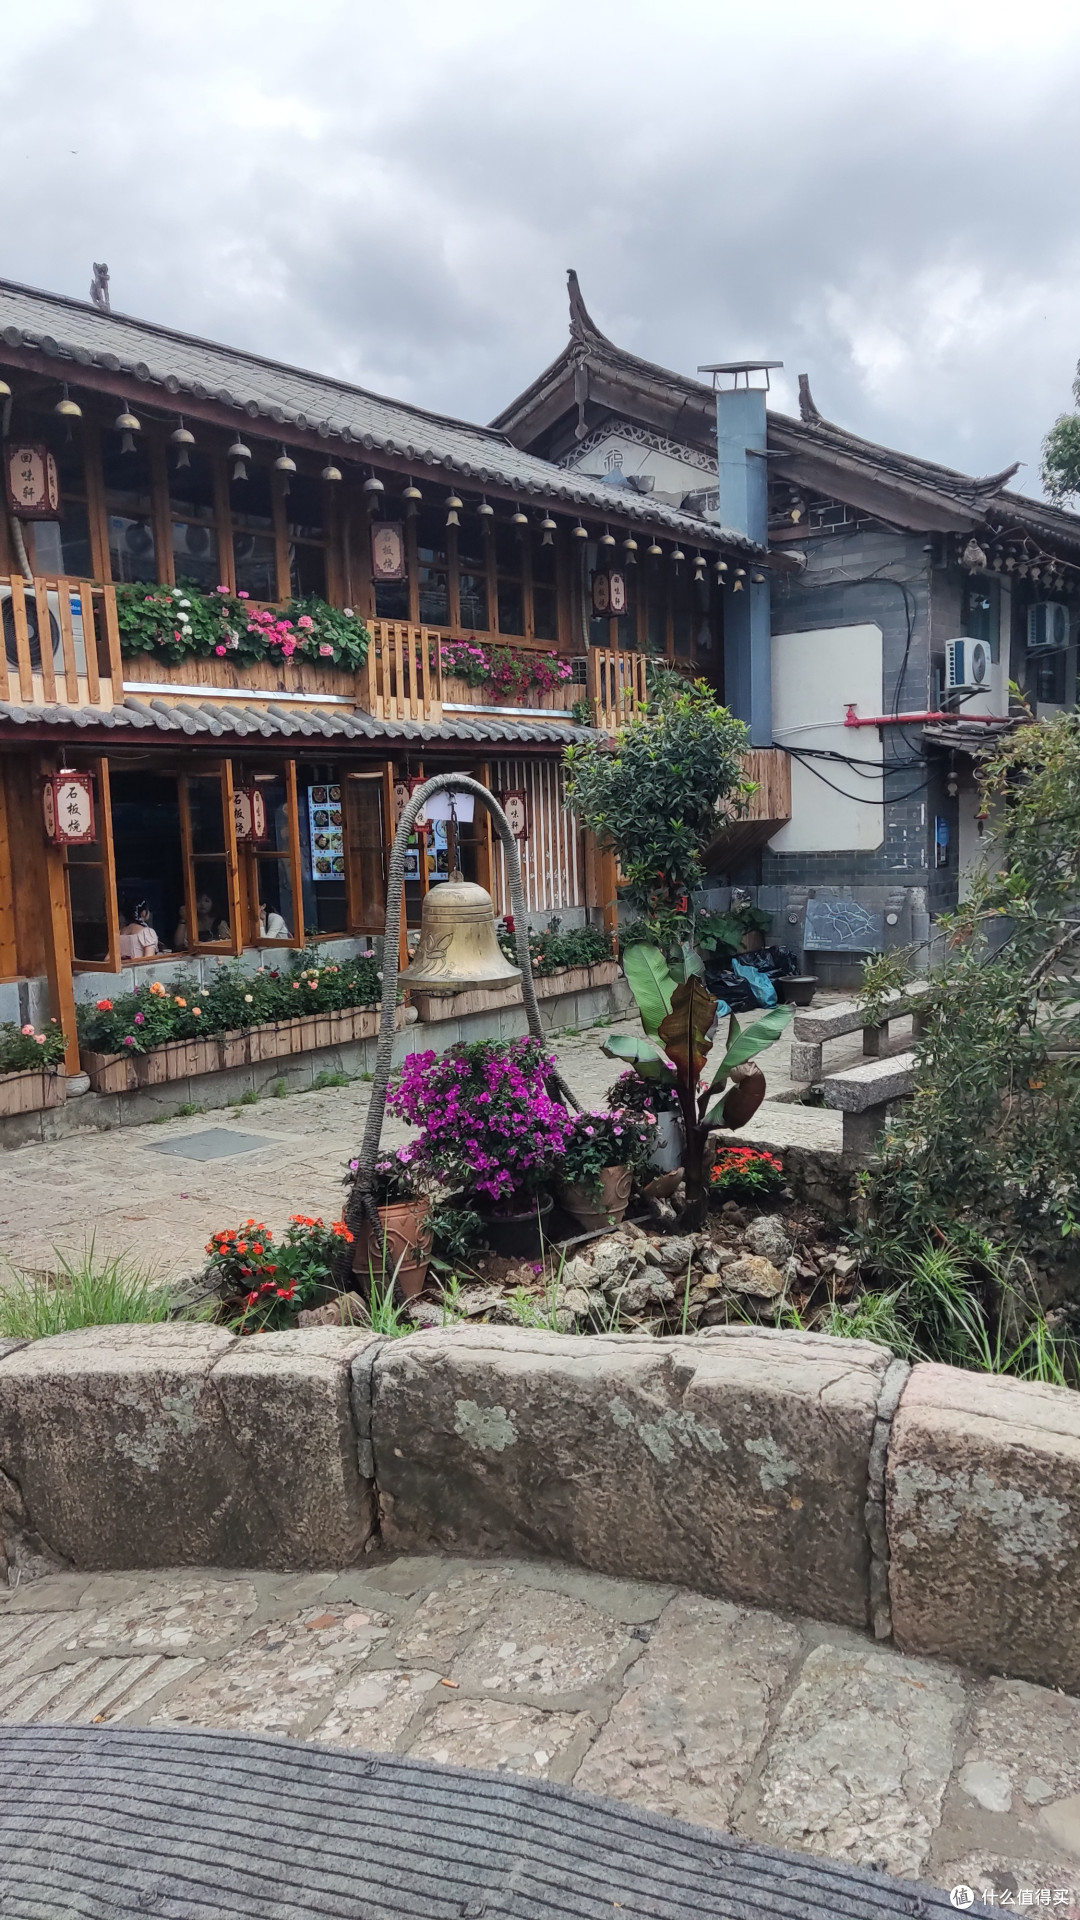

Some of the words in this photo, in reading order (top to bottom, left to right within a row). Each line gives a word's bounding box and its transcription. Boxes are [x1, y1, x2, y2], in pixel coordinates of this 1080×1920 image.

[21, 453, 35, 500] 回味轩
[66, 786, 82, 832] 石板烧
[234, 794, 245, 833] 石板烧
